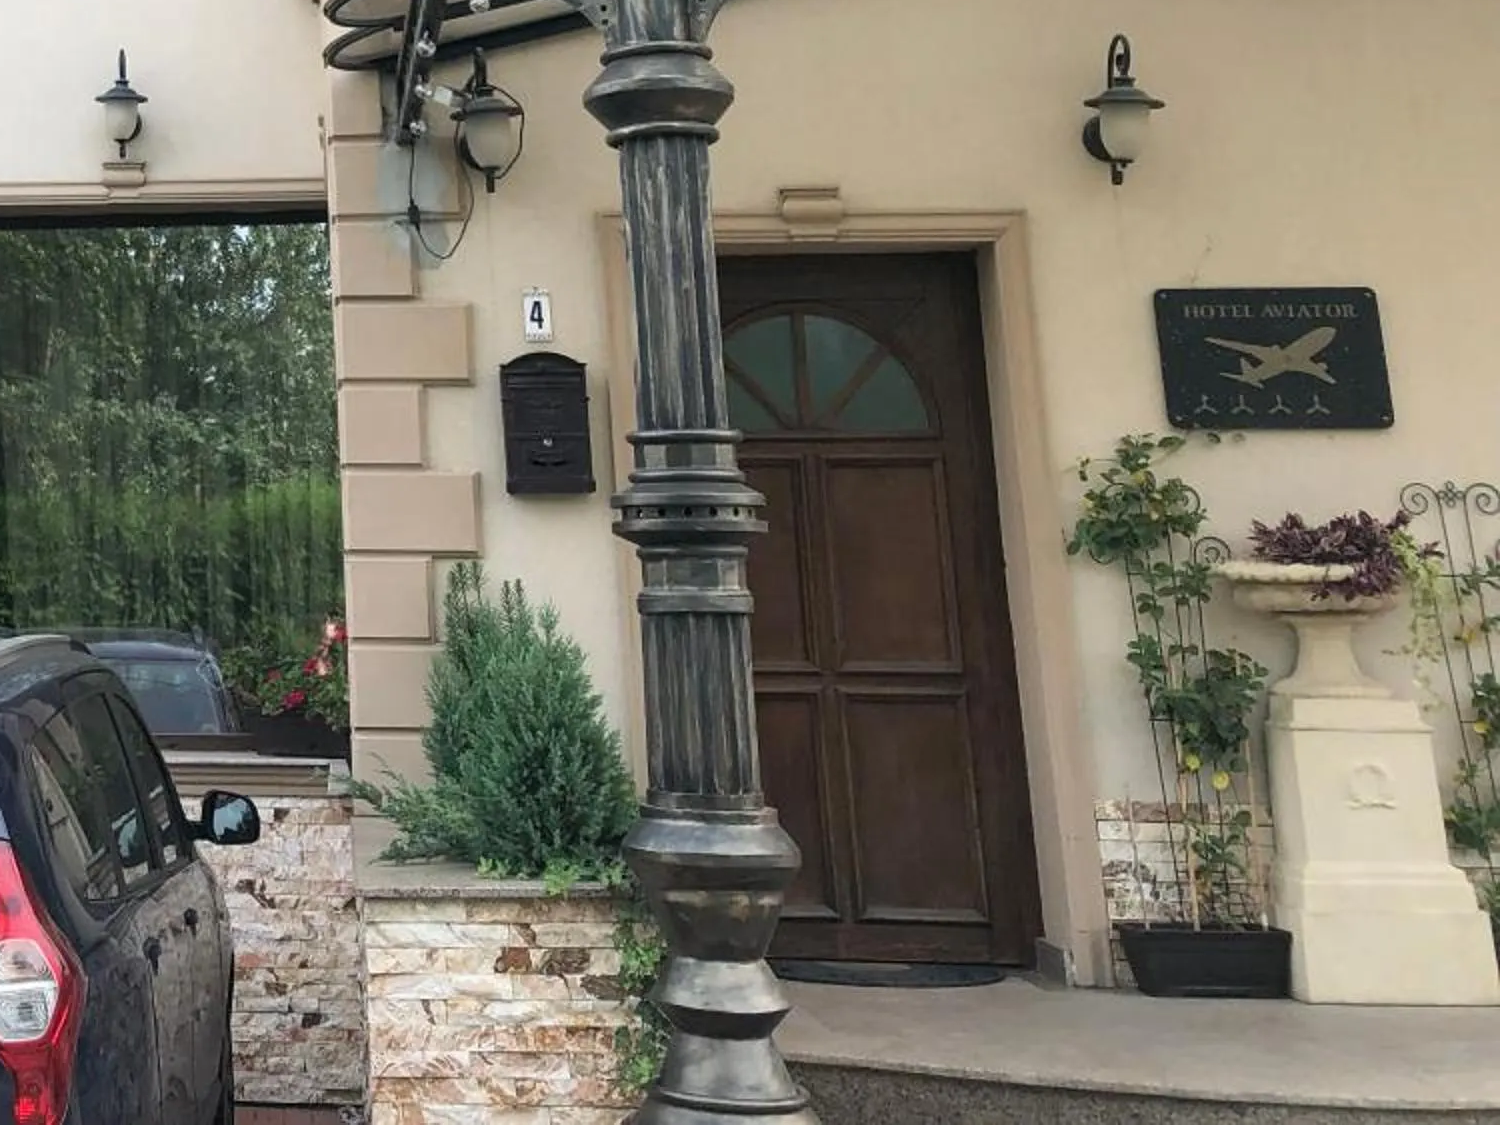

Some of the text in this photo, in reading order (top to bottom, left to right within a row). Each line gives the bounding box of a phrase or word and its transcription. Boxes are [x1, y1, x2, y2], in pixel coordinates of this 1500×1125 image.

[529, 300, 545, 330] 4
[1184, 302, 1359, 319] HOTEL AVIATOR
